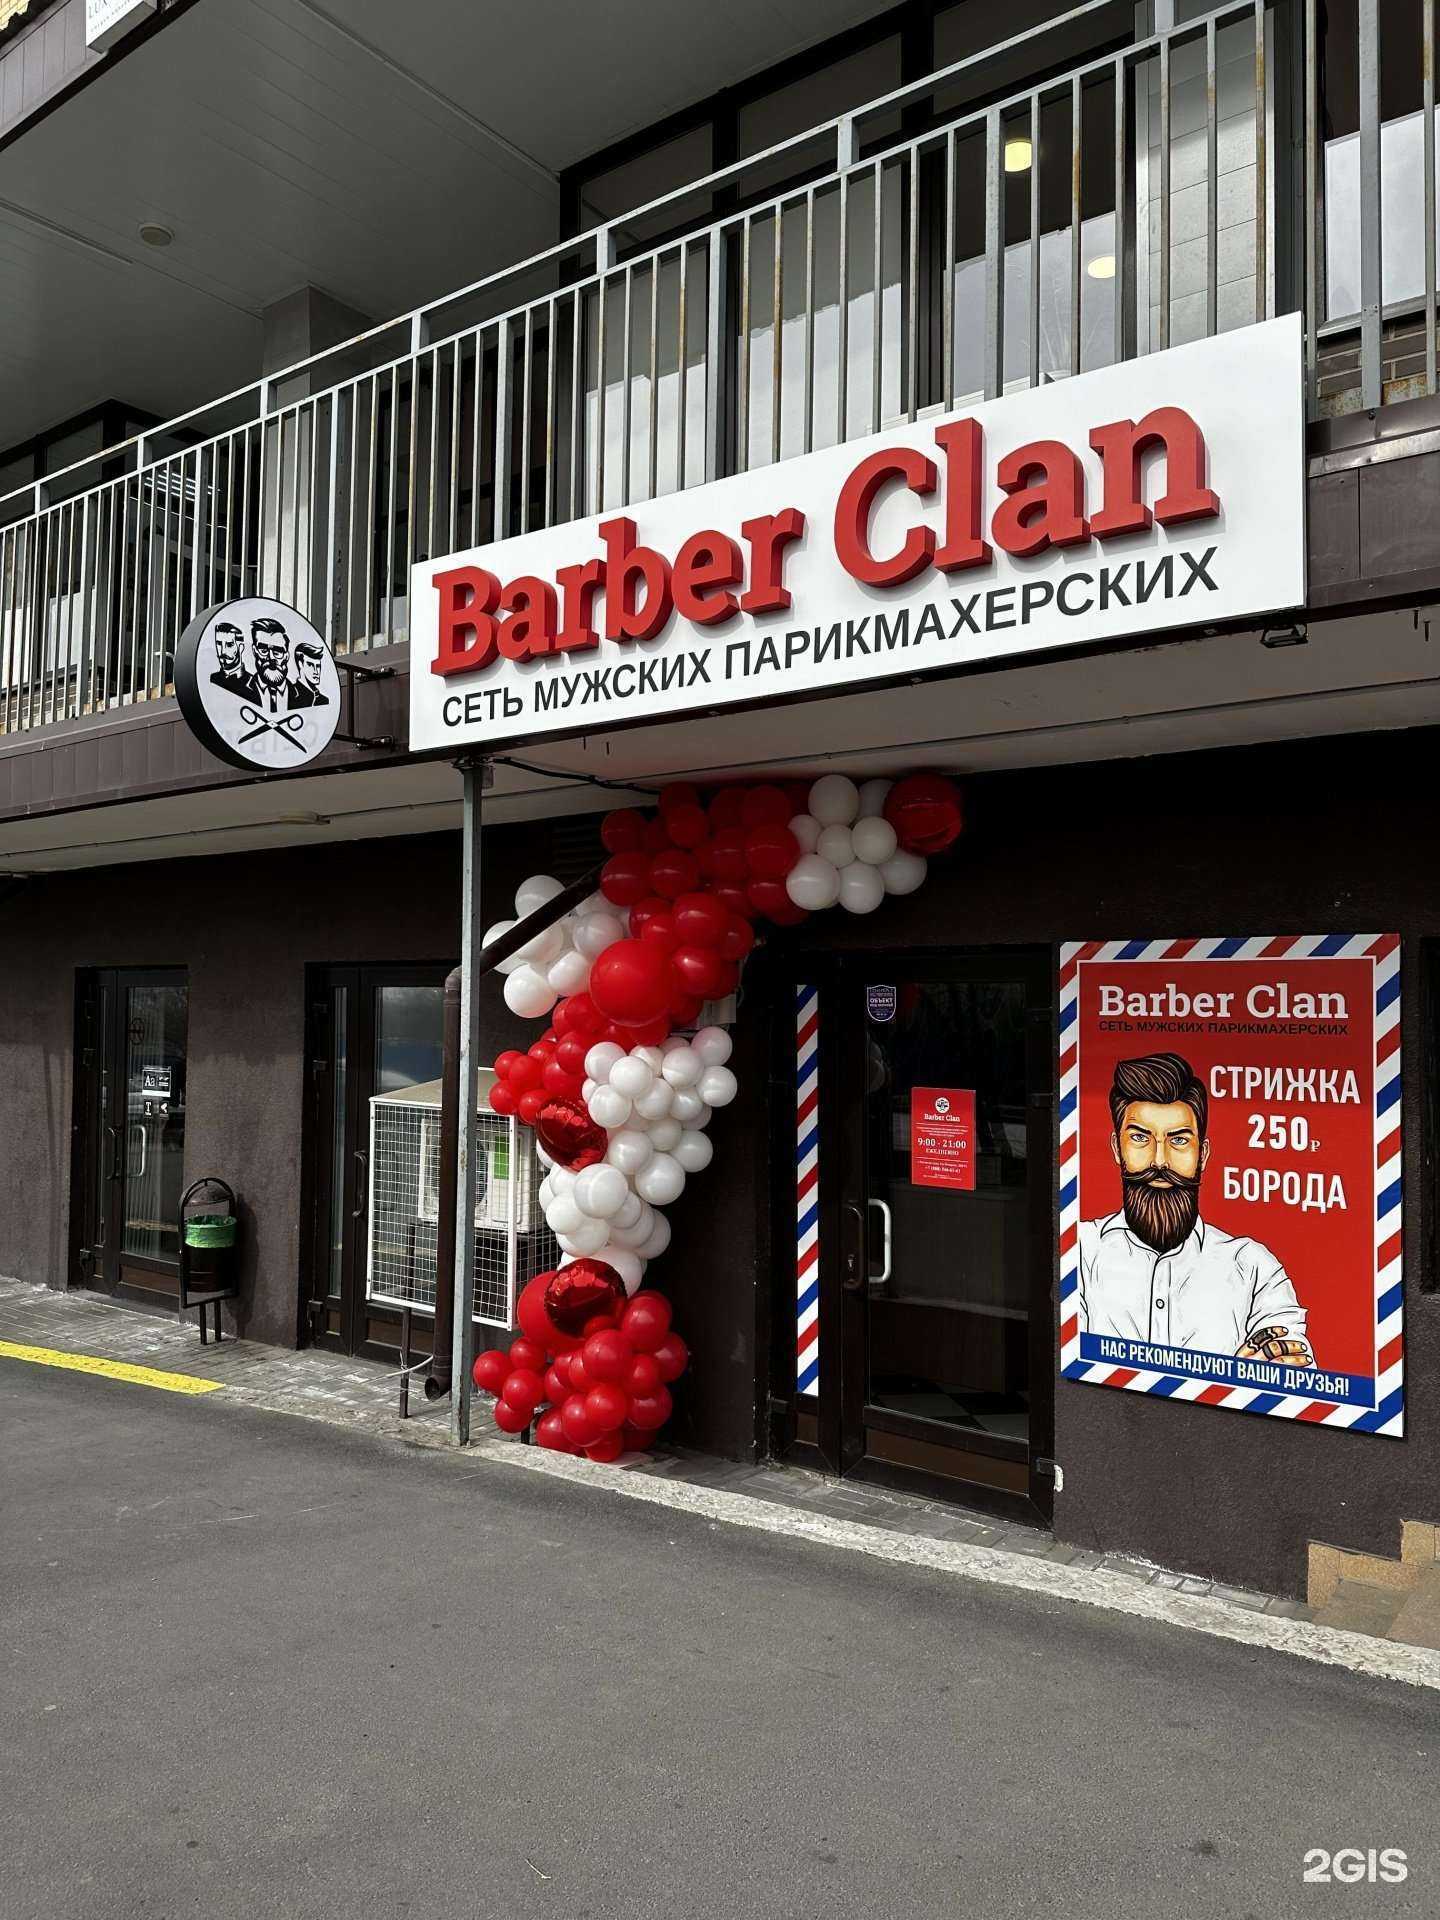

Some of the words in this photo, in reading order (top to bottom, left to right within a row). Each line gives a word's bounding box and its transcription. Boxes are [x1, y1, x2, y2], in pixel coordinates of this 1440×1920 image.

[431, 507, 806, 677] Barber
[834, 406, 1220, 588] Clan
[442, 686, 524, 728] СЕТЬ
[534, 648, 712, 713] МУЖСКИХ
[725, 546, 1219, 680] ПАРИКМАХЕРСКИХ
[1098, 983, 1235, 1018] Barber
[1246, 982, 1349, 1019] Clan
[1099, 1020, 1133, 1032] СЕТЬ
[1137, 1022, 1204, 1033] МУЖСКИХ
[1208, 1022, 1348, 1036] ПАРИКМАХЕРСКИХ
[1210, 1065, 1361, 1104] СТРИЖКА
[924, 1113, 945, 1121] Barber
[945, 1114, 961, 1122] Clan
[917, 1137, 936, 1147] 9:00
[942, 1139, 967, 1149] 21:00
[1223, 1166, 1348, 1214] БОРОДА
[1100, 1339, 1127, 1359] НАС
[1129, 1344, 1235, 1376] РЕКОМЕНДУЮТ
[1237, 1361, 1281, 1386] ВАШИ
[1283, 1369, 1350, 1397] ДРУЗЬЯ!
